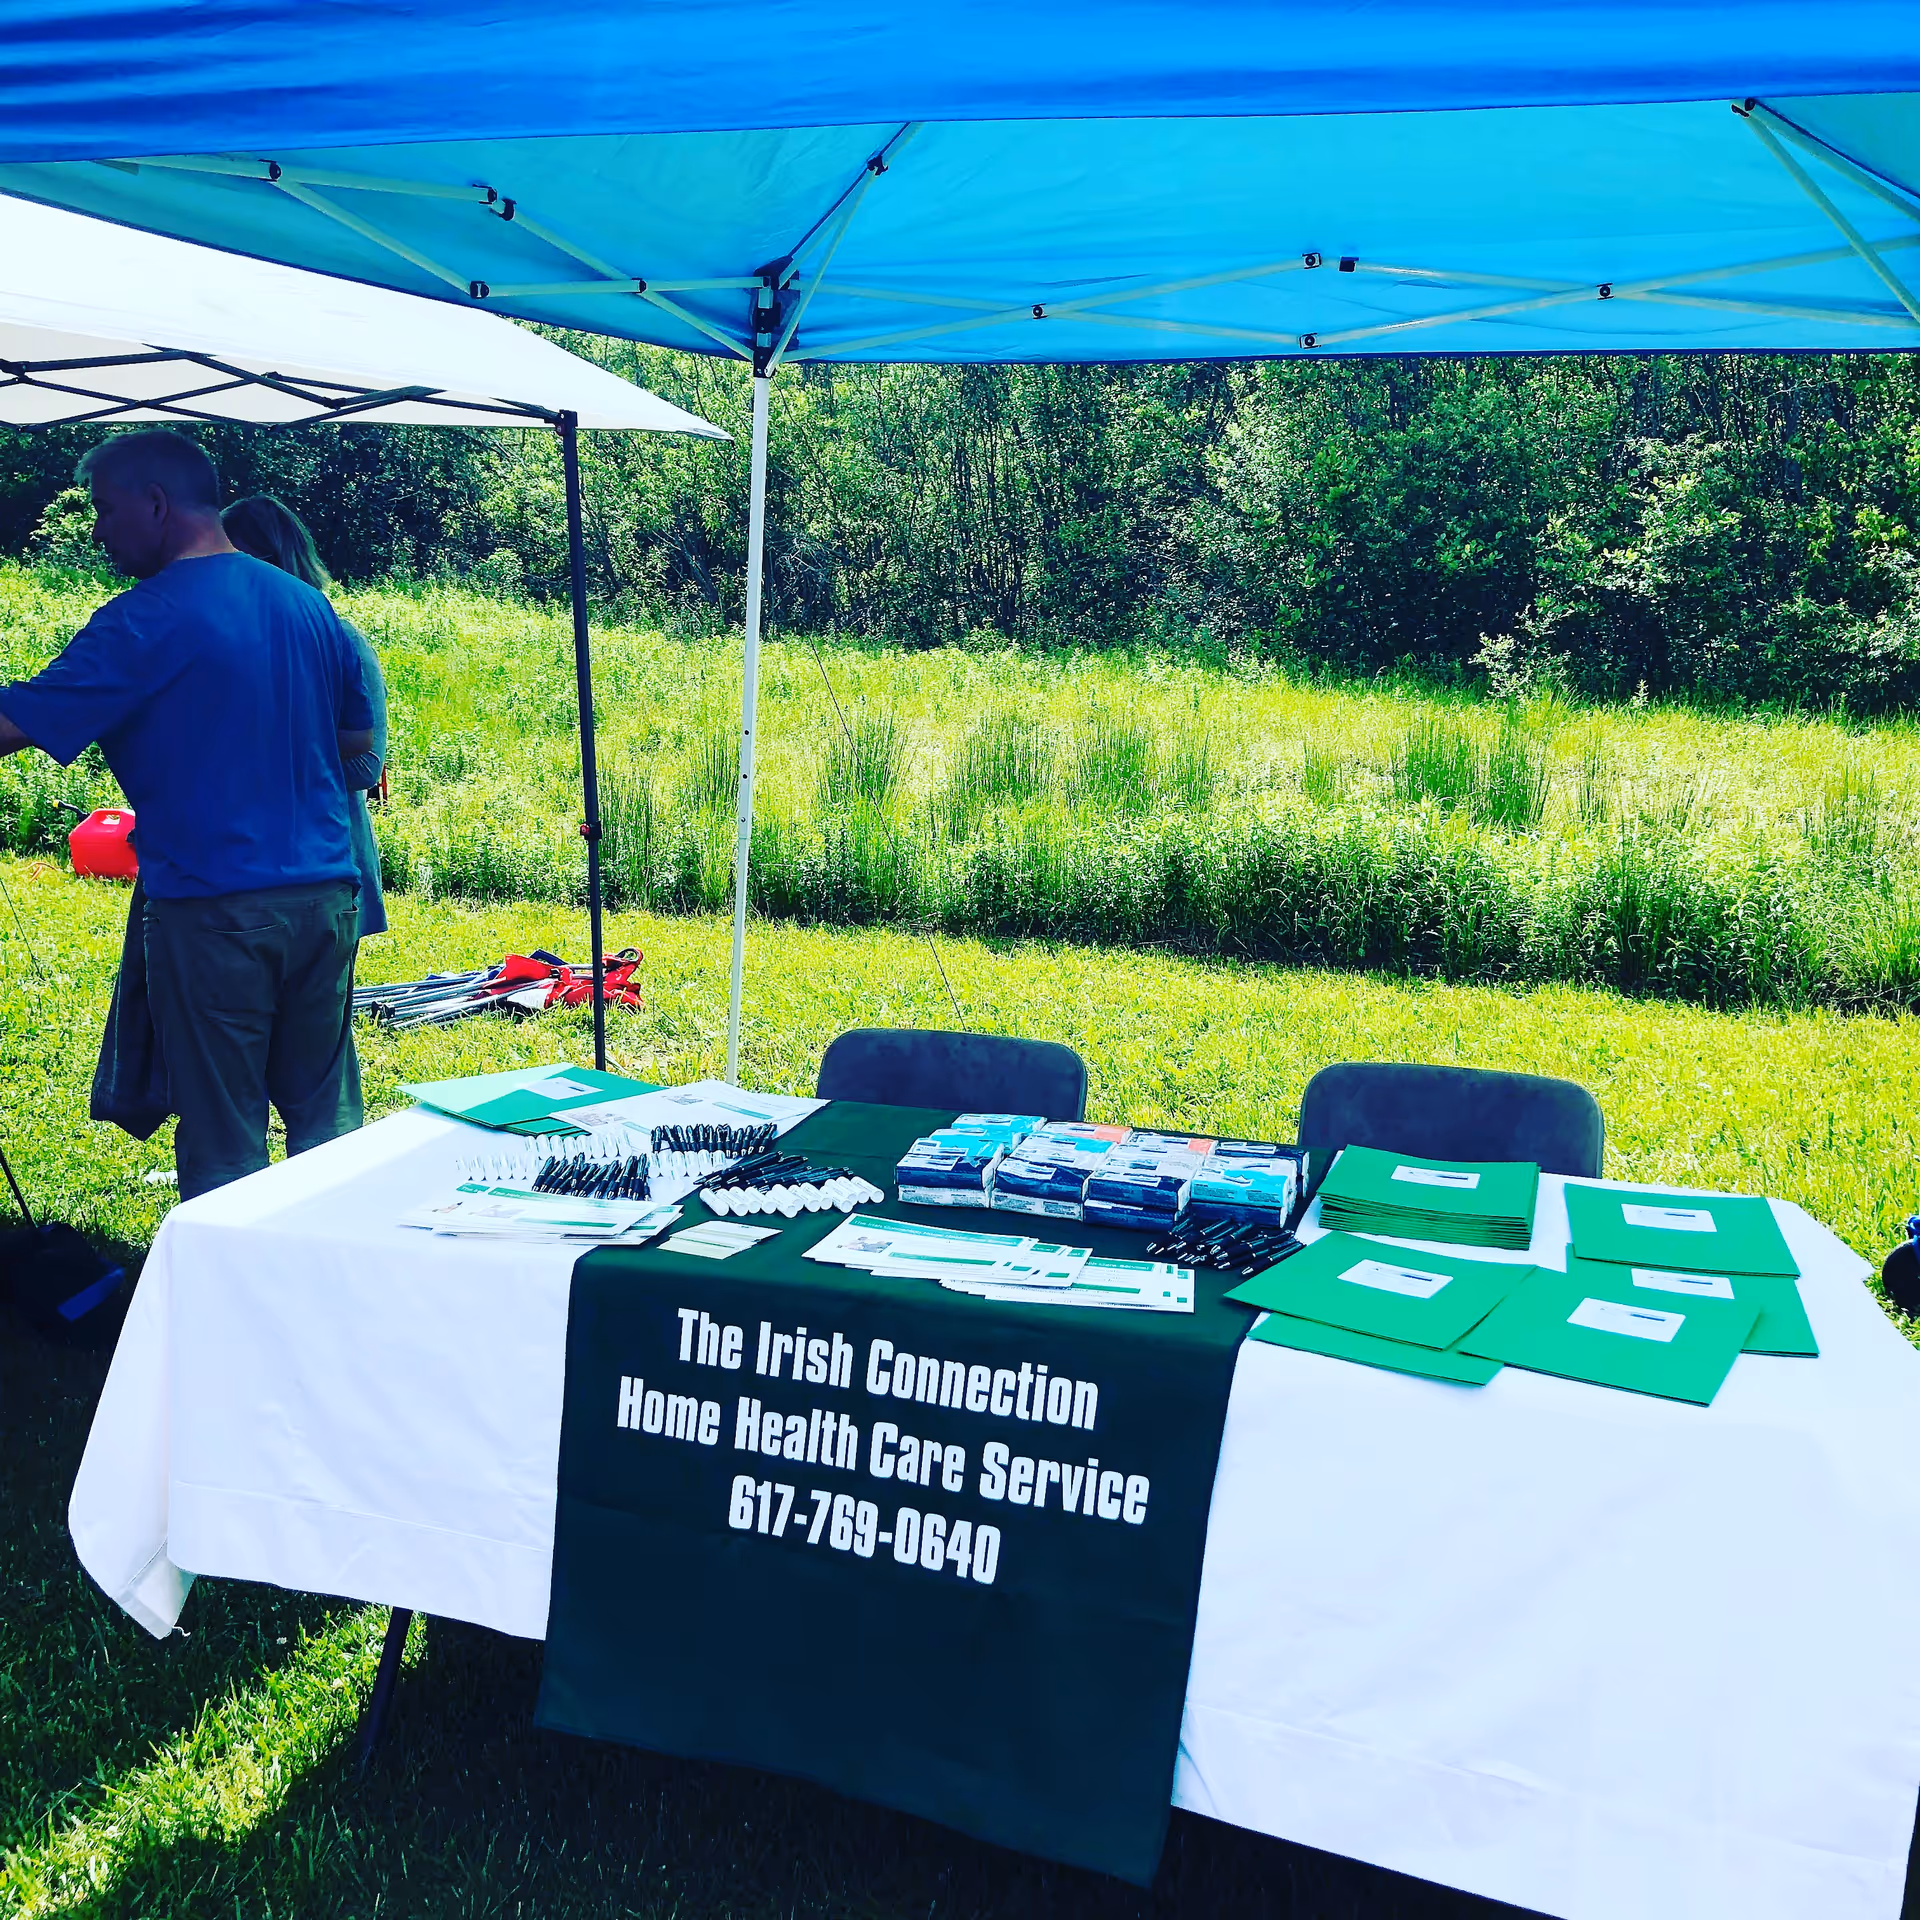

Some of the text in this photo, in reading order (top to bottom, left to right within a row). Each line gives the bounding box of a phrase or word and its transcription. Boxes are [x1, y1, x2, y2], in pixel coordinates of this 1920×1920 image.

[677, 1308, 1099, 1431] The Irish Connection
[616, 1375, 1150, 1525] Home Health Care Service
[728, 1475, 1001, 1585] 617-769-0640
